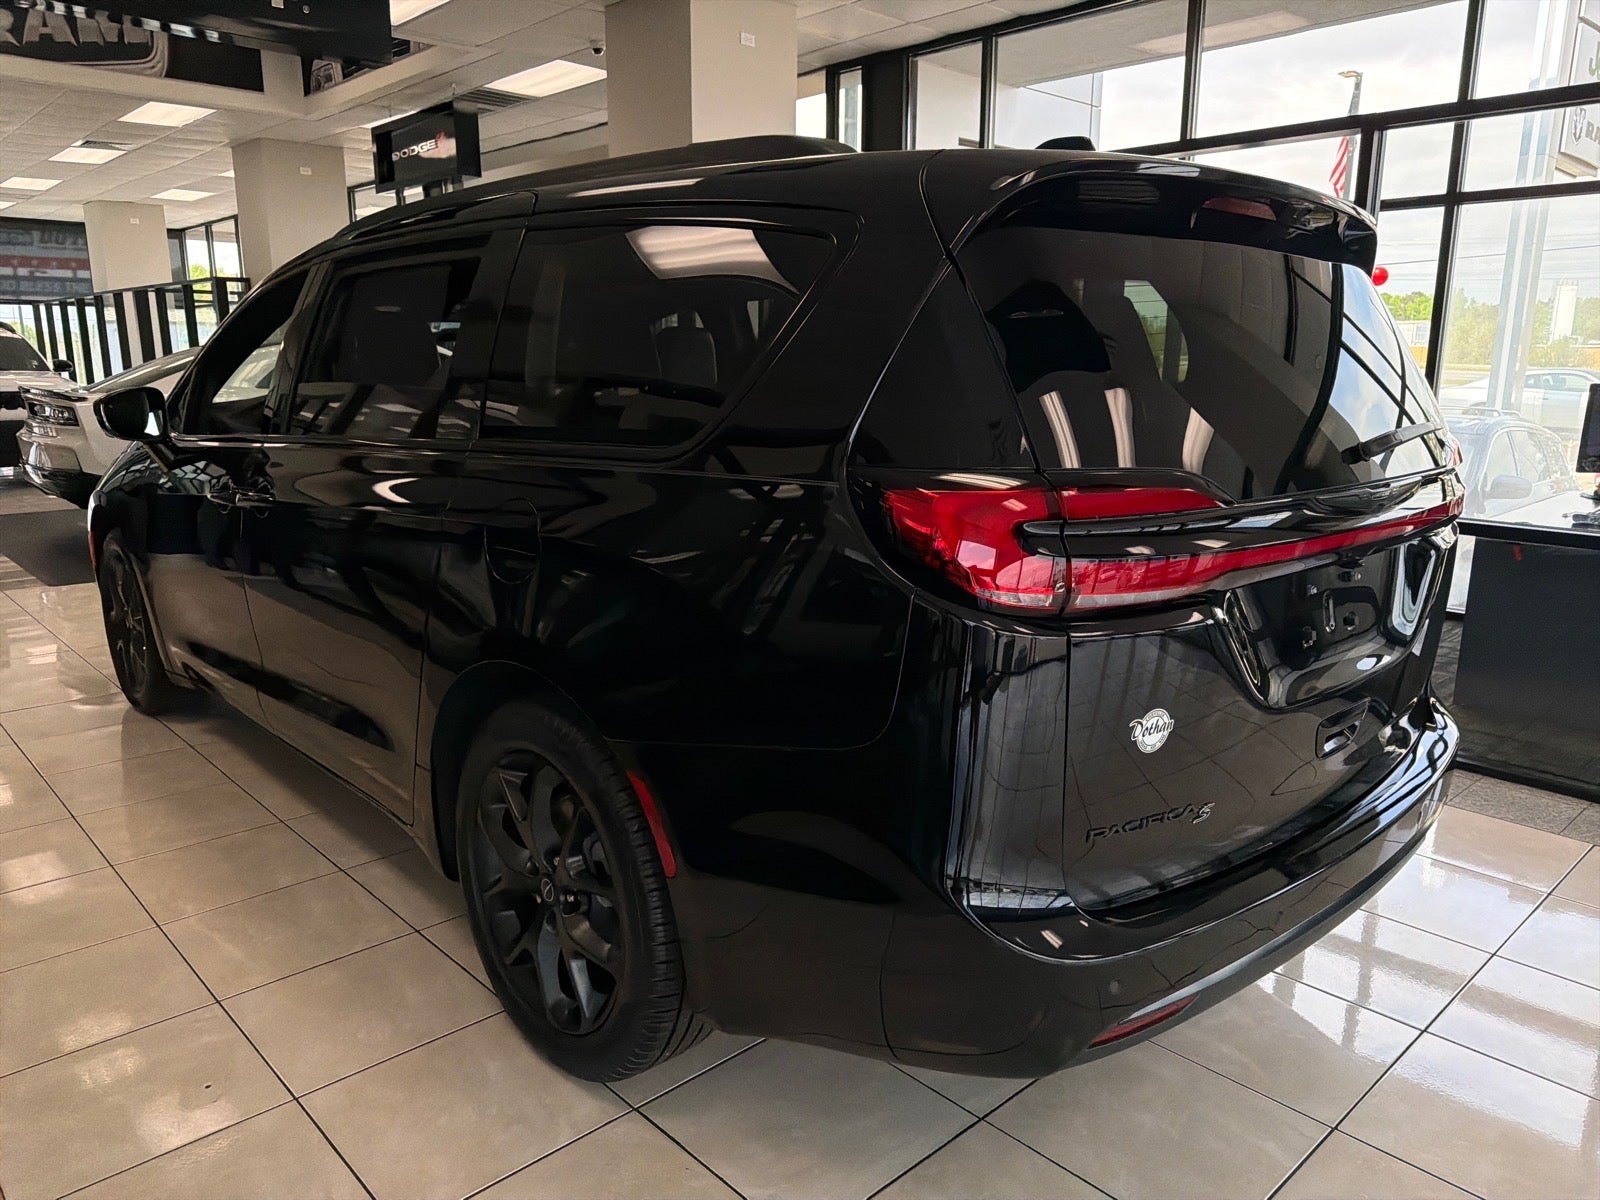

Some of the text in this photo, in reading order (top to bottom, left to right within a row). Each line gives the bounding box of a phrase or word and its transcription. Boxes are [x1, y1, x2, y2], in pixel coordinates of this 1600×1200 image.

[392, 139, 436, 161] DODGE
[1129, 718, 1174, 740] Dothan
[1086, 803, 1197, 842] PACIFICA
